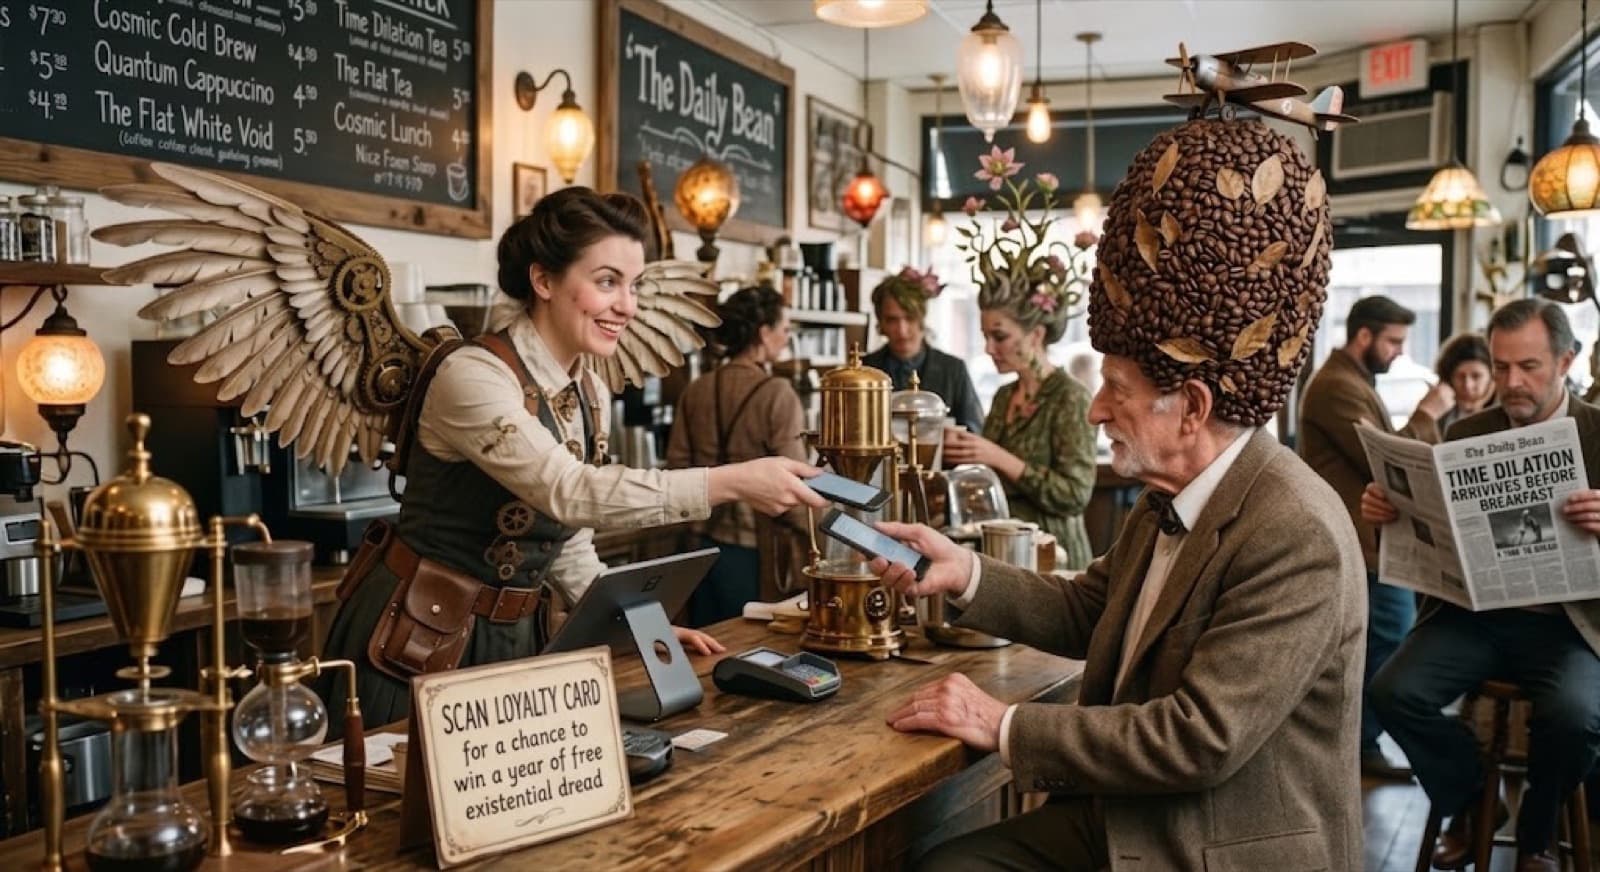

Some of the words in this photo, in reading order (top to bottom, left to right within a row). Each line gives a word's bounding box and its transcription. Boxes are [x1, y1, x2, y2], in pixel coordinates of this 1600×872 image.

[94, 0, 163, 40] Cosmic
[168, 13, 207, 52] Cold
[214, 23, 257, 63] Brew
[334, 0, 369, 34] Time
[372, 10, 425, 52] Dilation
[425, 27, 448, 59] Tea
[94, 40, 179, 87] Quantum
[184, 58, 275, 105] Cappuccino
[334, 52, 360, 85] The
[363, 60, 389, 92] Flat
[391, 67, 414, 98] Tea
[1369, 43, 1414, 85] EXIT
[95, 90, 132, 127] The
[139, 97, 176, 135] Flat
[181, 104, 233, 143] White
[237, 115, 273, 151] Void
[334, 101, 388, 139] Cosmic
[391, 112, 432, 149] Lunch
[679, 60, 729, 147] Daily
[1445, 465, 1490, 489] TIME
[1493, 448, 1576, 481] DILATION
[1524, 467, 1578, 489] BEFORE
[1479, 486, 1555, 512] BREAKFAST
[441, 696, 490, 735] SCAN
[494, 685, 558, 724] LOYALTY
[563, 678, 602, 711] CARD
[463, 740, 489, 767] for
[495, 740, 507, 754] a
[511, 726, 567, 751] chance
[571, 720, 589, 737] to
[454, 770, 487, 793] win
[492, 769, 503, 784] a
[507, 758, 545, 787] year
[550, 747, 567, 772] of
[571, 745, 604, 770] free
[466, 779, 553, 820] existential
[557, 768, 604, 797] dread
